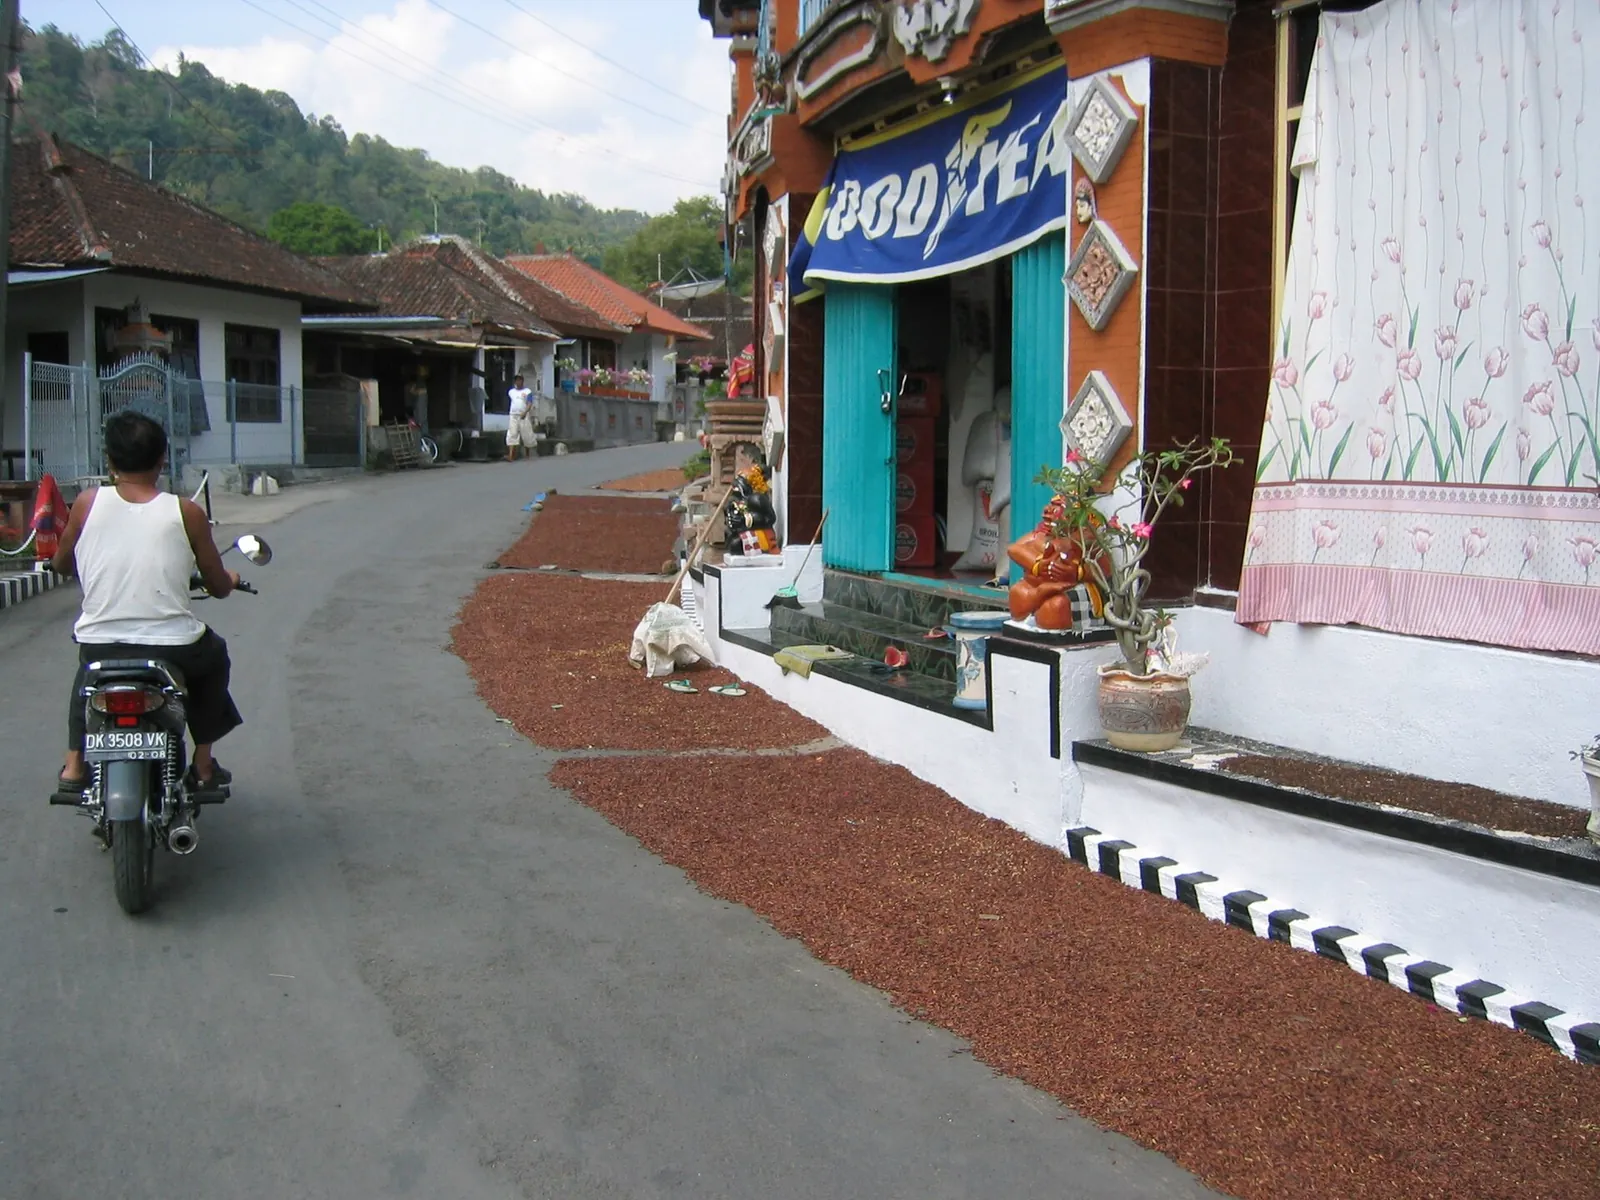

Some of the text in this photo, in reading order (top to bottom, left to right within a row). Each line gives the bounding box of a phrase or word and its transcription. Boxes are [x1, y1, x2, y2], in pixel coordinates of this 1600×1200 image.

[819, 99, 1067, 241] OODYEA
[86, 732, 164, 749] DK 3508 VK
